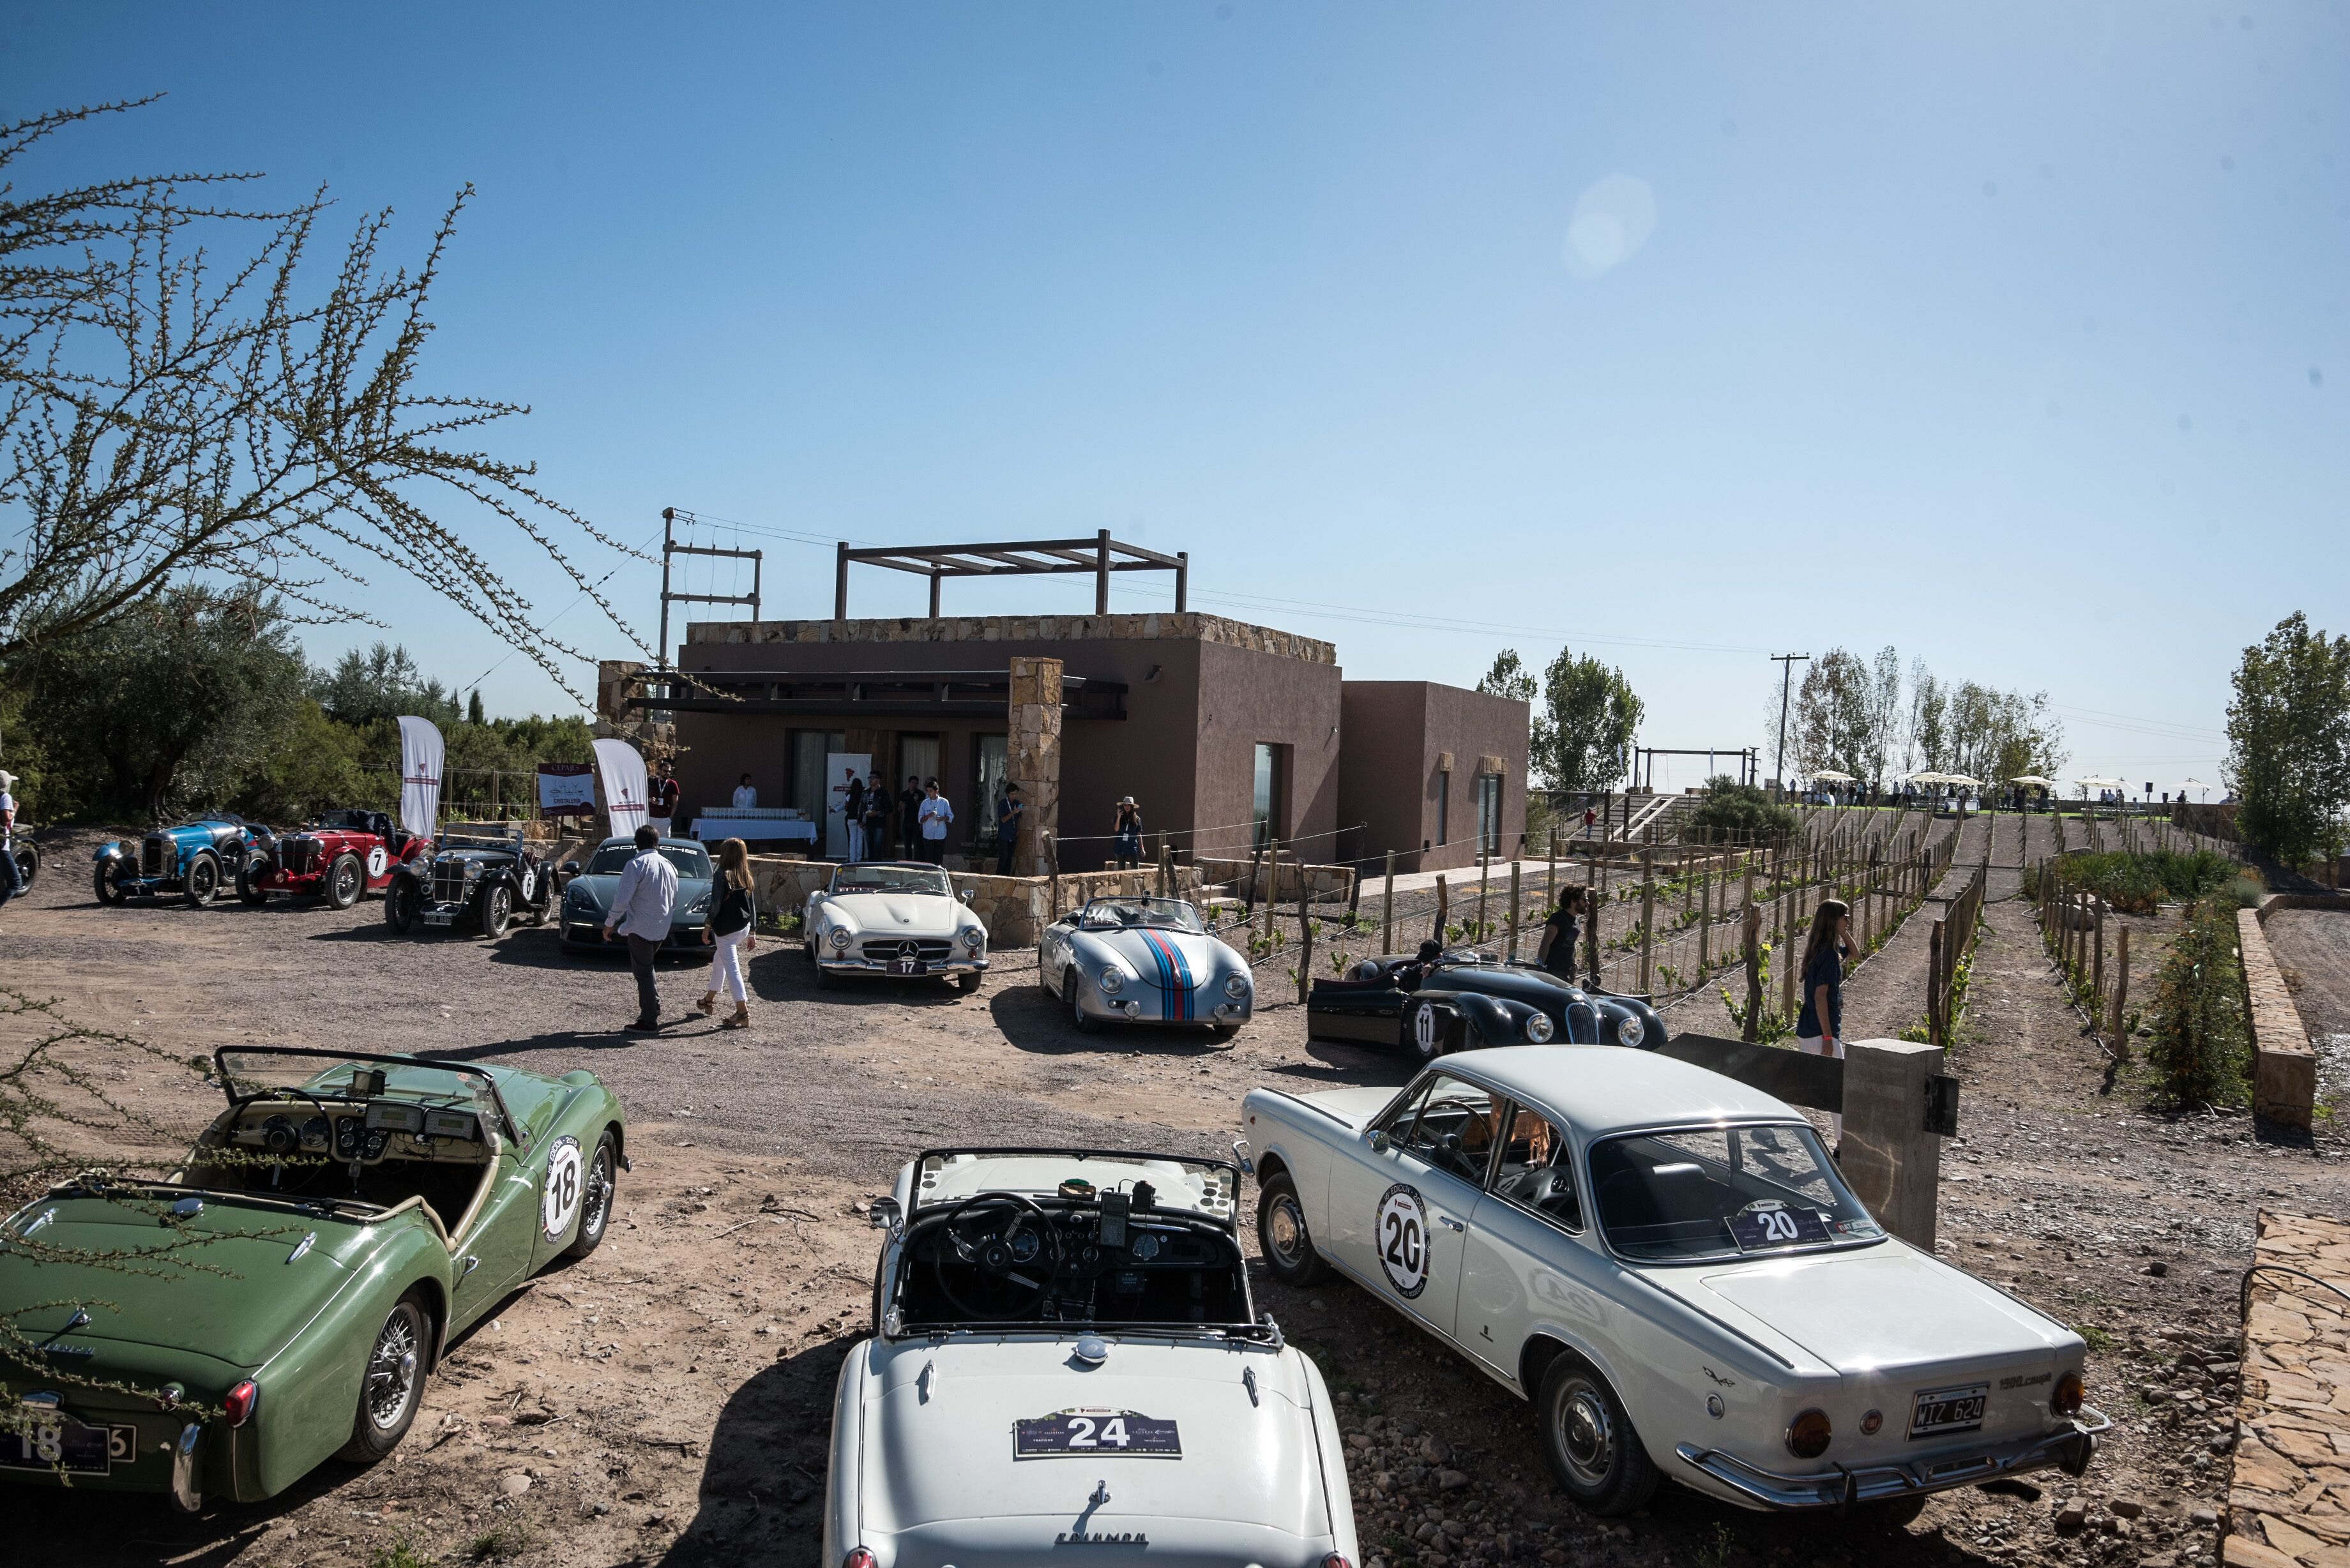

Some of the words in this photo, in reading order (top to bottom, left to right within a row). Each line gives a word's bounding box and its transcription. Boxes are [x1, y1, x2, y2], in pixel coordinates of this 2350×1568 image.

[607, 845, 698, 856] POCHE
[374, 854, 382, 871] 7
[275, 873, 284, 883] MG
[527, 877, 532, 895] 6
[900, 961, 915, 973] 17
[1419, 1014, 1430, 1043] 11
[565, 1137, 577, 1147] 2018
[552, 1160, 575, 1221] 18
[1413, 1193, 1424, 1213] 2018
[1757, 1210, 1798, 1240] 20
[1386, 1211, 1420, 1274] 20
[1409, 1281, 1424, 1297] BODEGAS
[1916, 1403, 1947, 1426] WIZ
[1954, 1398, 1983, 1421] 624
[1068, 1417, 1130, 1446] 24
[15, 1425, 62, 1461] 18
